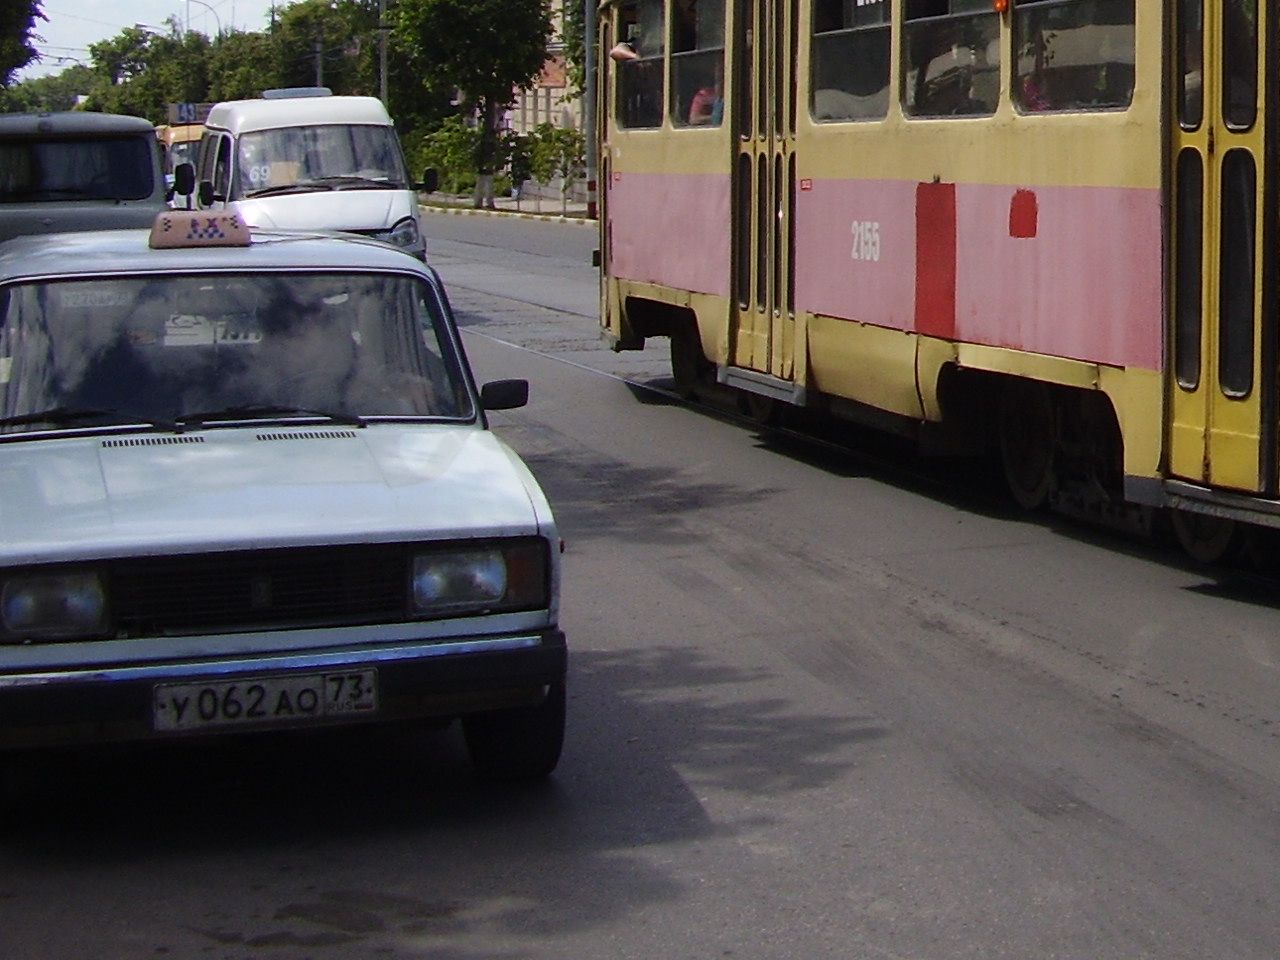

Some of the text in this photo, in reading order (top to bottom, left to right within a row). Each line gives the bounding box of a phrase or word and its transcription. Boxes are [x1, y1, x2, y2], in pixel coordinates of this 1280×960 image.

[249, 166, 270, 181] 69
[851, 220, 880, 261] 2155
[328, 675, 365, 702] 73
[326, 701, 353, 713] RUS
